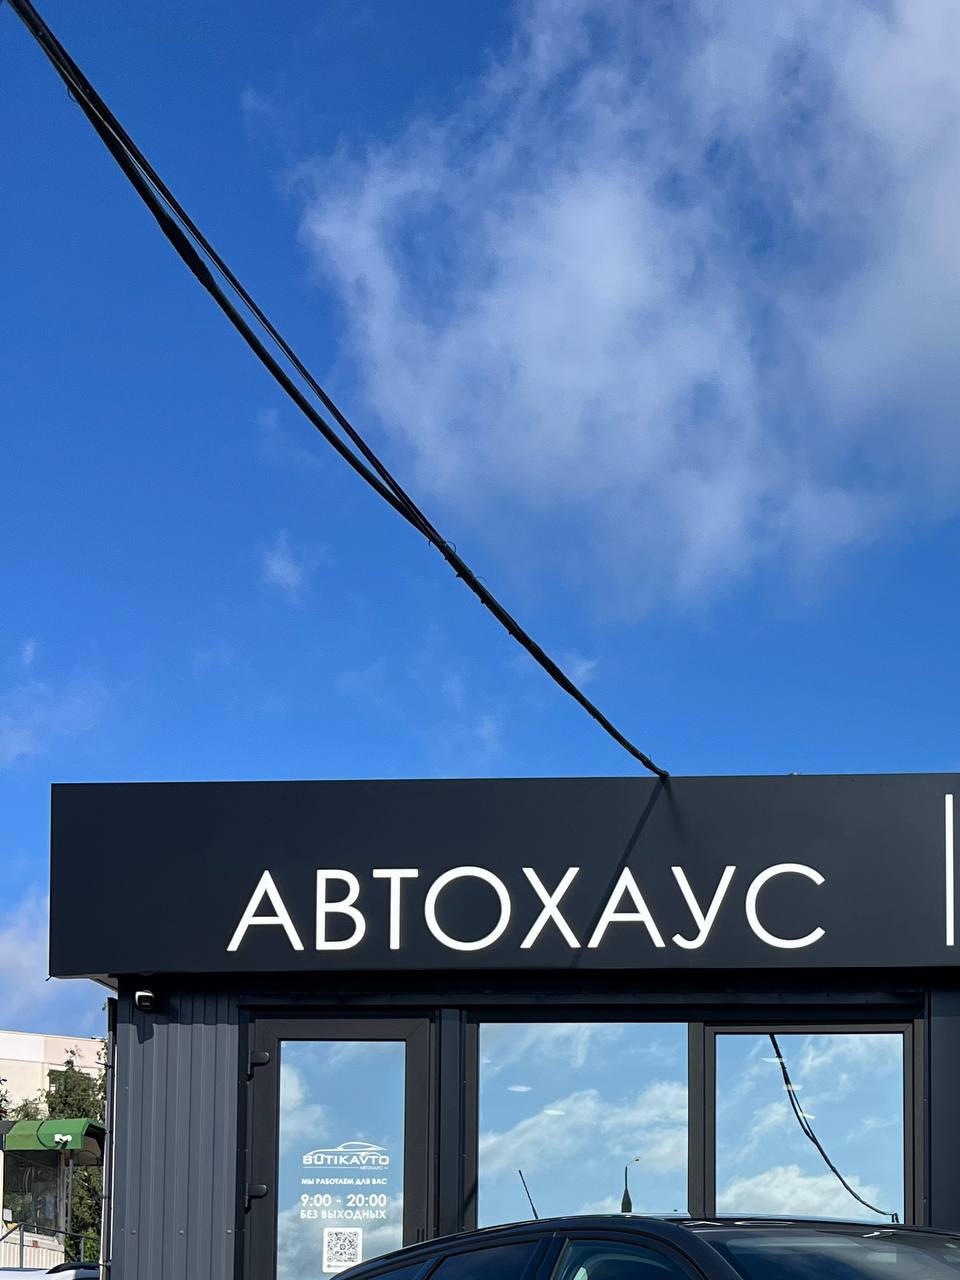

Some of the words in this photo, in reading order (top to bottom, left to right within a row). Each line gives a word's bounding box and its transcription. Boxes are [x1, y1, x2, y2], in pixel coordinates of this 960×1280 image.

[227, 863, 826, 952] АВТОХАУС
[302, 1154, 390, 1166] BUTIKAVTO
[355, 1178, 371, 1186] ДЛЯ
[300, 1194, 332, 1207] 9:00
[346, 1194, 387, 1207] 20:00
[300, 1209, 319, 1219] БЕЗ
[321, 1209, 387, 1220] ВЫХОДНЫХ
